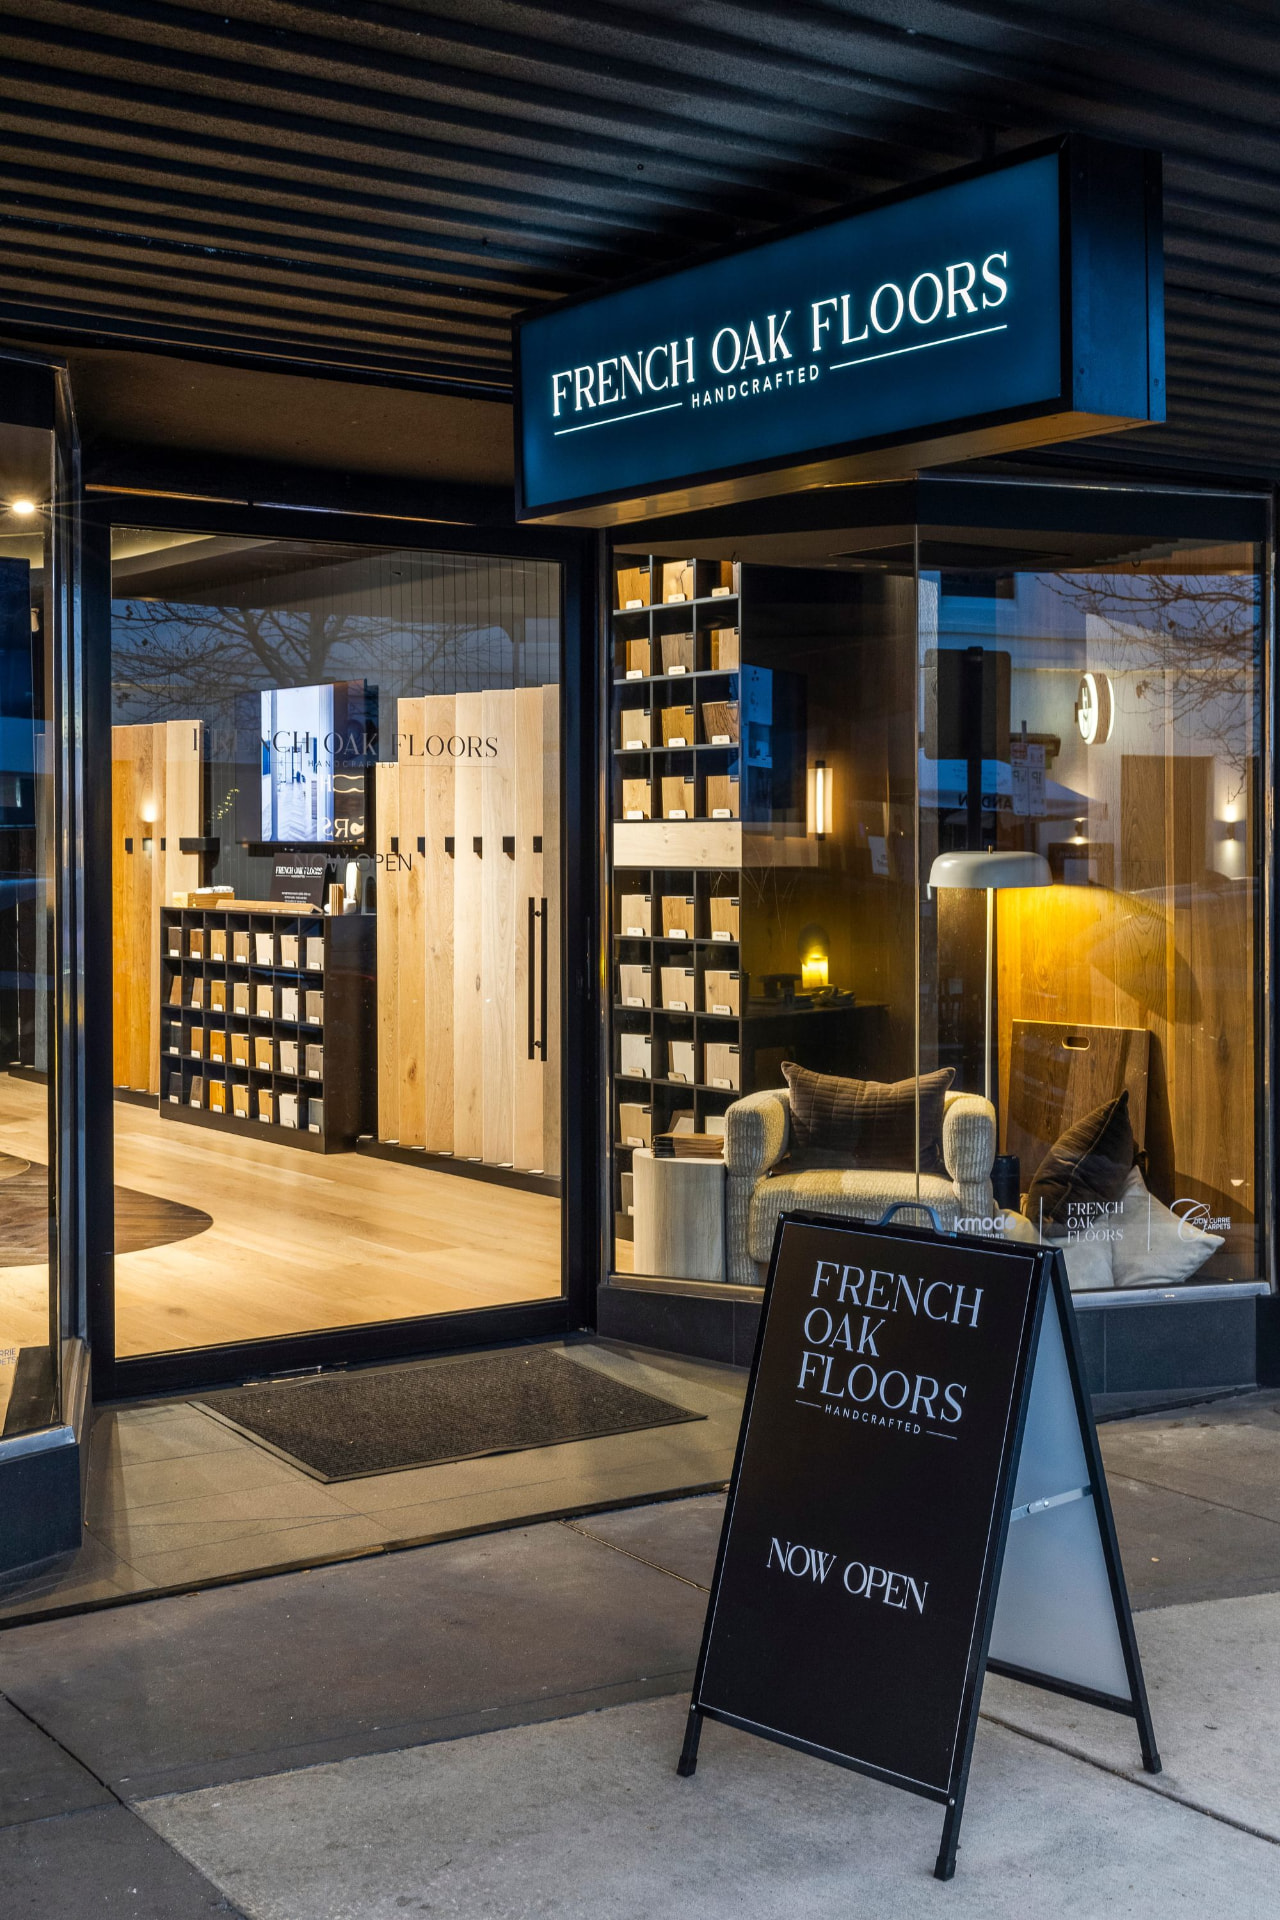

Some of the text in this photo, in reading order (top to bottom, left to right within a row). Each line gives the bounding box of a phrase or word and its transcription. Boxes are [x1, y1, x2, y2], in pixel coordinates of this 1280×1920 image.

[552, 250, 1009, 418] FRENCH OAK FLOORS
[690, 363, 821, 410] HANDCRAFTED
[324, 731, 378, 756] OAK
[391, 734, 498, 758] FLOORS
[356, 853, 412, 872] OPEN
[1067, 1201, 1124, 1216] FRENCH
[1067, 1215, 1095, 1229] OAK
[1209, 1216, 1231, 1224] CURRIE
[1067, 1229, 1124, 1244] FLOORS
[810, 1259, 984, 1328] FRENCH
[803, 1307, 886, 1358] OAK
[796, 1350, 967, 1424] FLOORS
[824, 1404, 922, 1436] HANDCRAFTED
[766, 1536, 929, 1615] NOW OPEN
